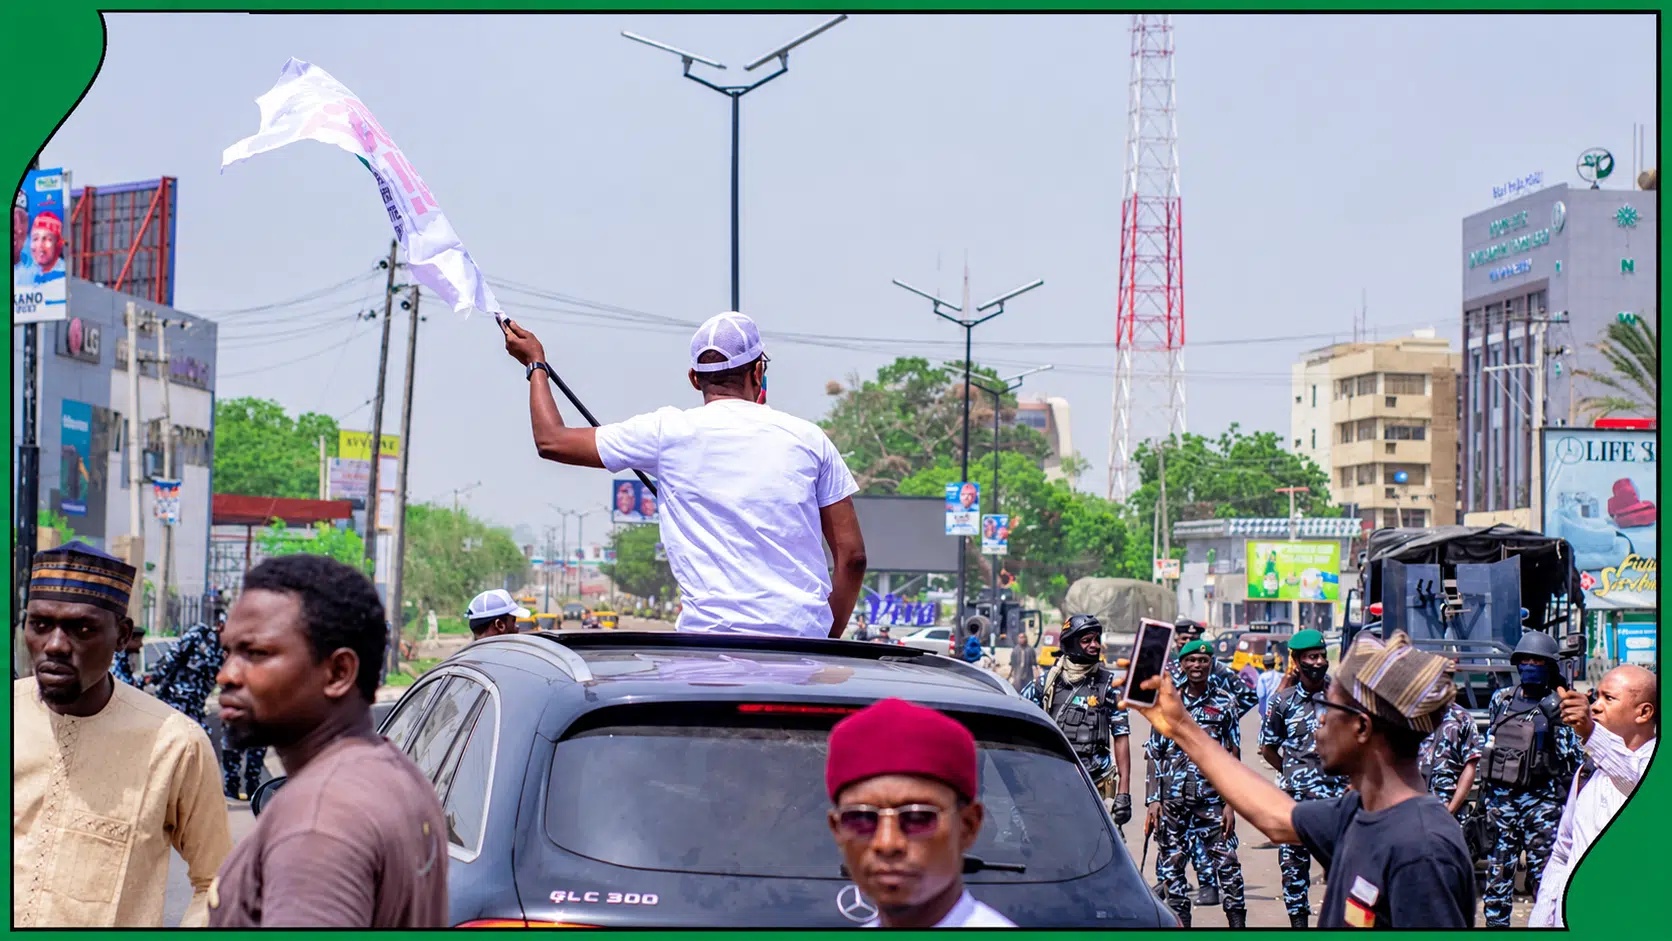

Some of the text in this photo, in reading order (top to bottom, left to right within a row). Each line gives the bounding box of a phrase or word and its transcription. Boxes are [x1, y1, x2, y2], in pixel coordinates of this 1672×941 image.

[84, 327, 99, 354] LG
[1586, 440, 1635, 462] LIFE
[549, 890, 659, 905] GLC 300
